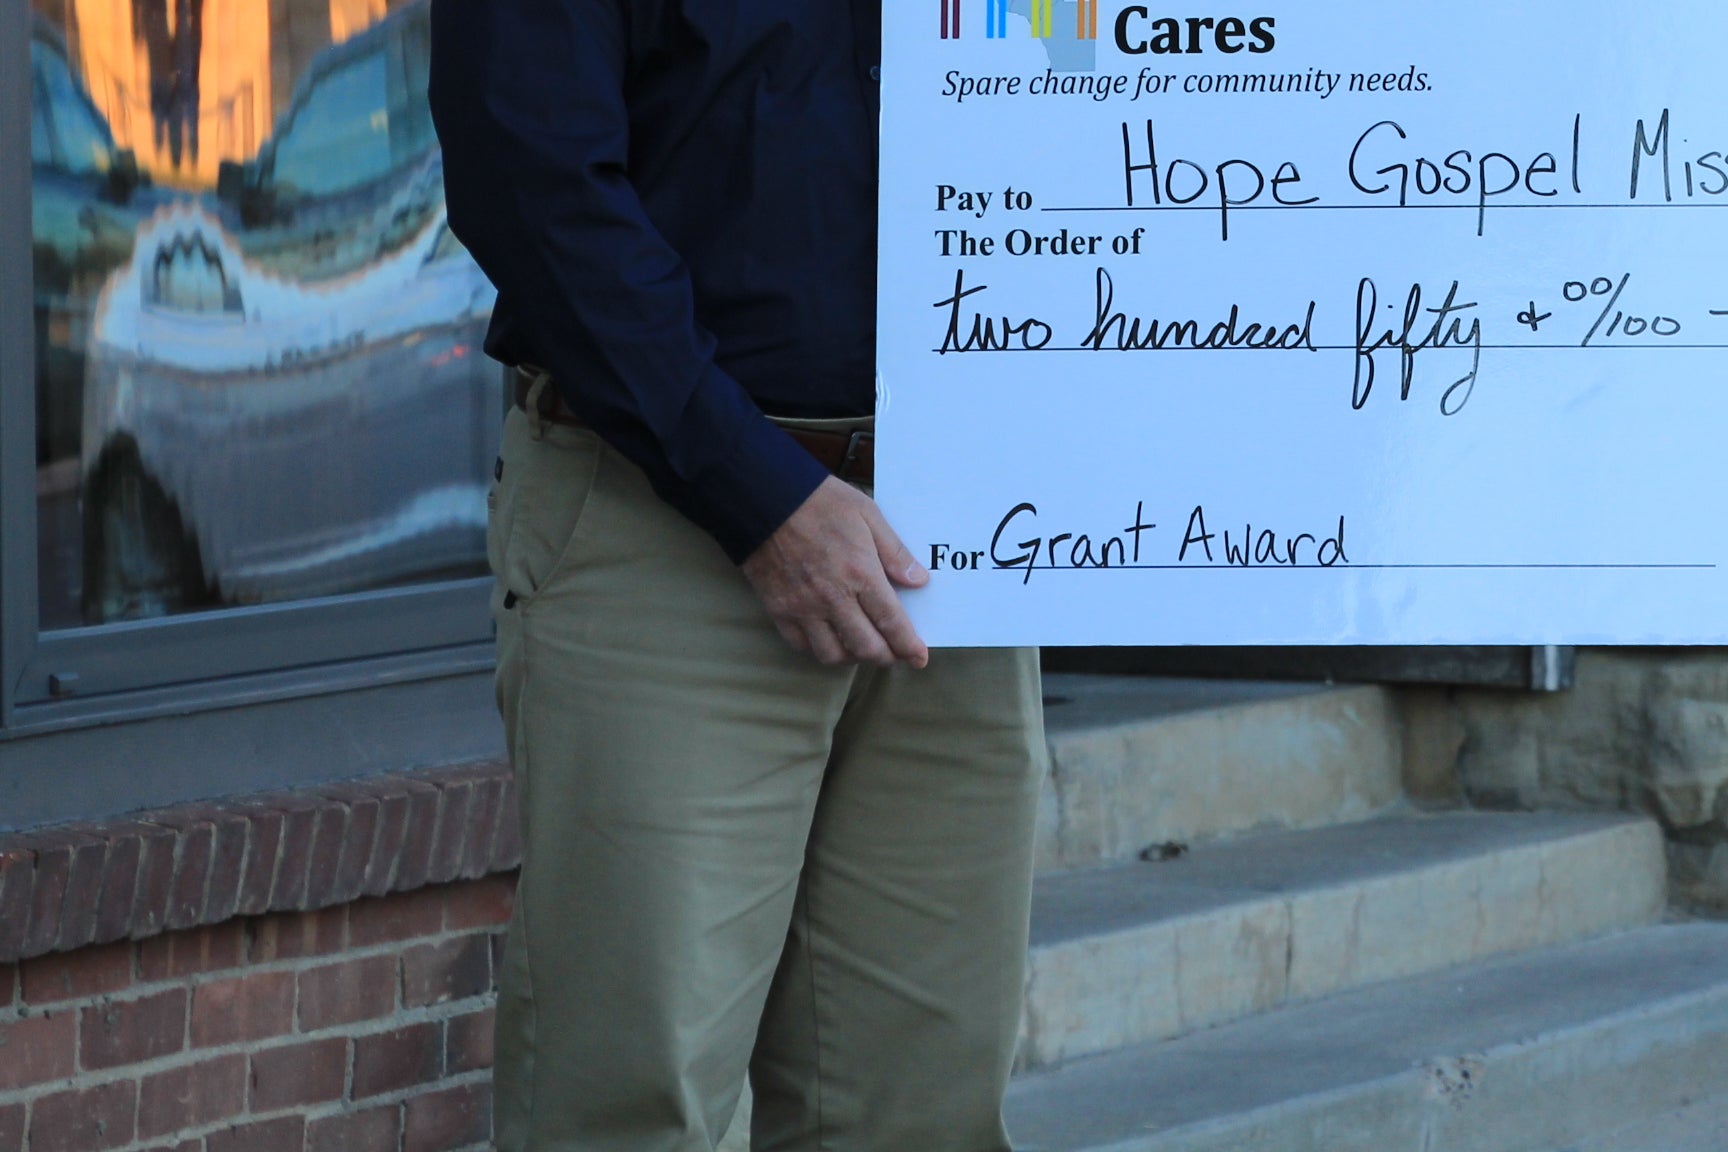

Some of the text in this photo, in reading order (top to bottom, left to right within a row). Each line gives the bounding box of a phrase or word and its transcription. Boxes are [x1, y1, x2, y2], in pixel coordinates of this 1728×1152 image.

[1113, 4, 1277, 55] Cares
[941, 65, 1434, 103] Spare change for community needs.
[1121, 119, 1320, 241] Hope
[1348, 113, 1581, 236] Gospel
[935, 183, 1034, 218] Pay to
[935, 228, 1147, 256] The Order of
[931, 268, 1053, 356] two
[1080, 267, 1318, 353] hundred
[1352, 277, 1482, 416] fifty
[929, 543, 985, 573] For
[990, 501, 1350, 585] Grant Award
